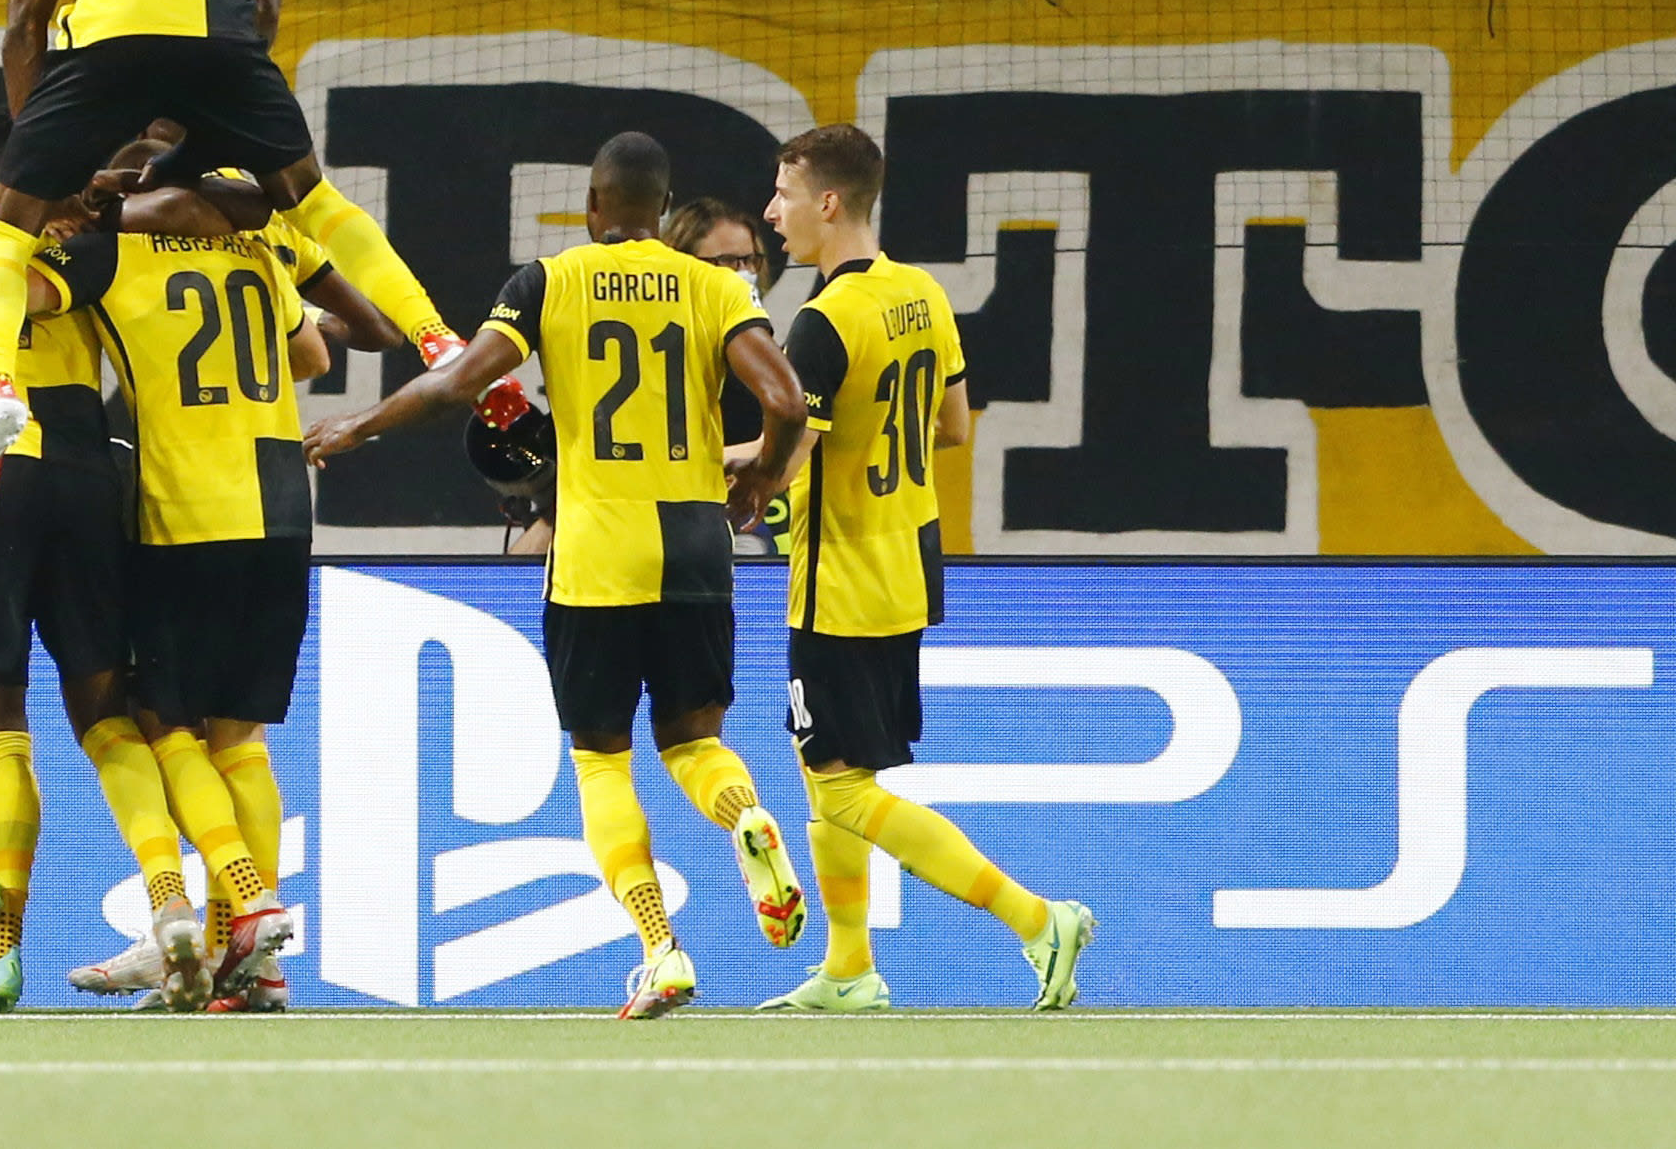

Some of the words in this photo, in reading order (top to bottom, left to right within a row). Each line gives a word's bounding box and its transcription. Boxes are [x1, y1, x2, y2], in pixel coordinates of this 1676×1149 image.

[165, 269, 280, 406] 20
[593, 272, 680, 302] GARCIA
[588, 320, 689, 461] 21
[867, 348, 937, 497] 30
[868, 647, 1654, 929] PS
